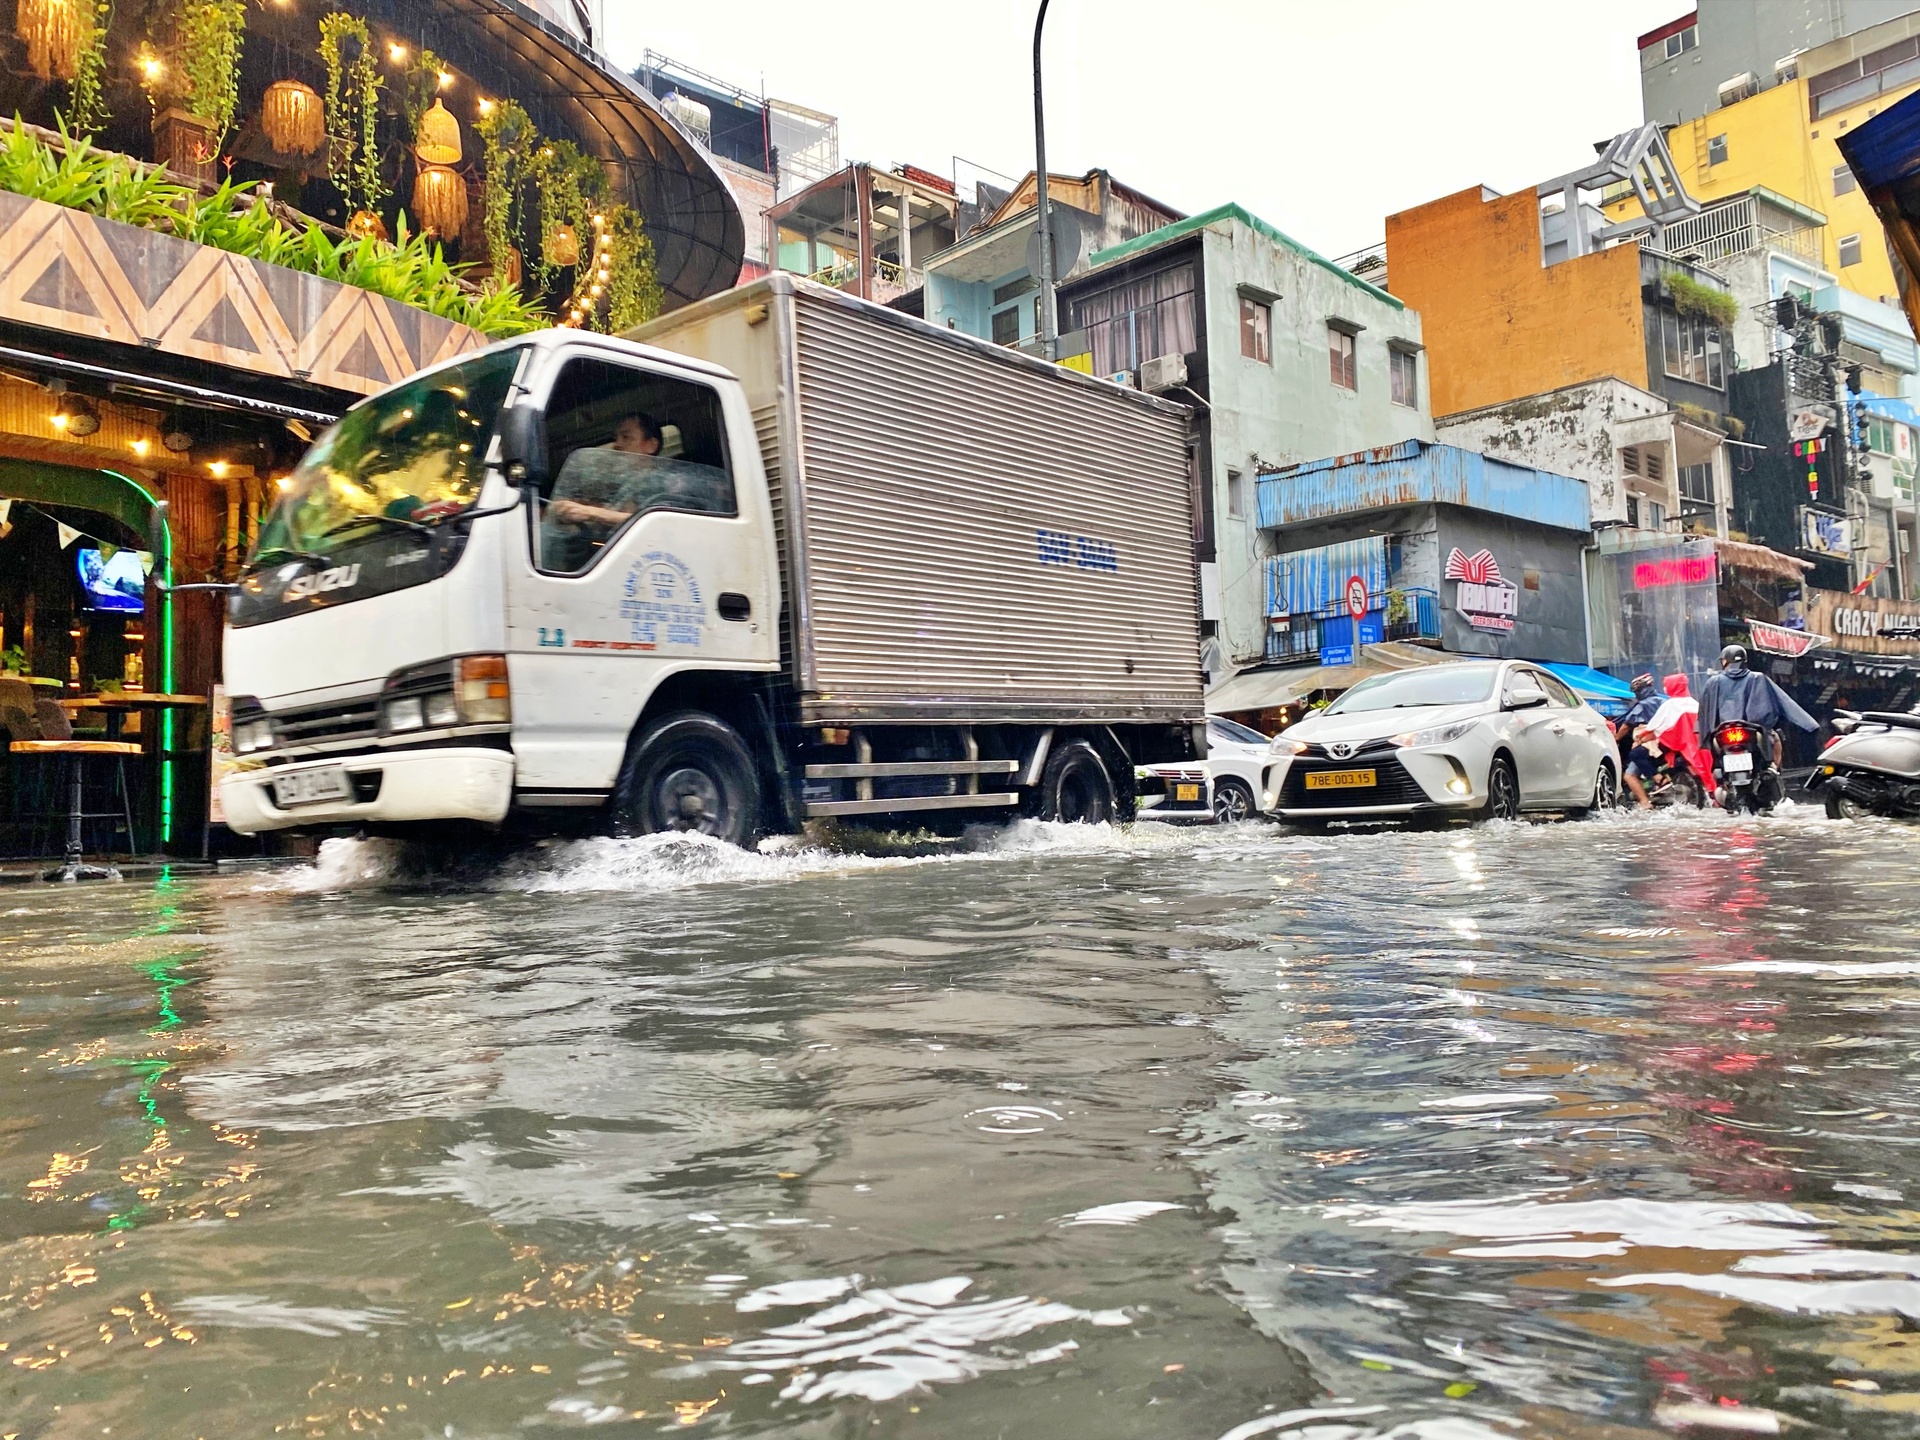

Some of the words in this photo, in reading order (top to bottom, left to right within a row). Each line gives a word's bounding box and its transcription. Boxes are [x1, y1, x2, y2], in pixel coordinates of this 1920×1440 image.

[1473, 616, 1486, 625] BEER
[1494, 619, 1514, 629] VIETNAM
[1834, 607, 1878, 637] CRAZY
[1883, 613, 1920, 640] NIGH
[1312, 773, 1370, 786] 78E-003.15
